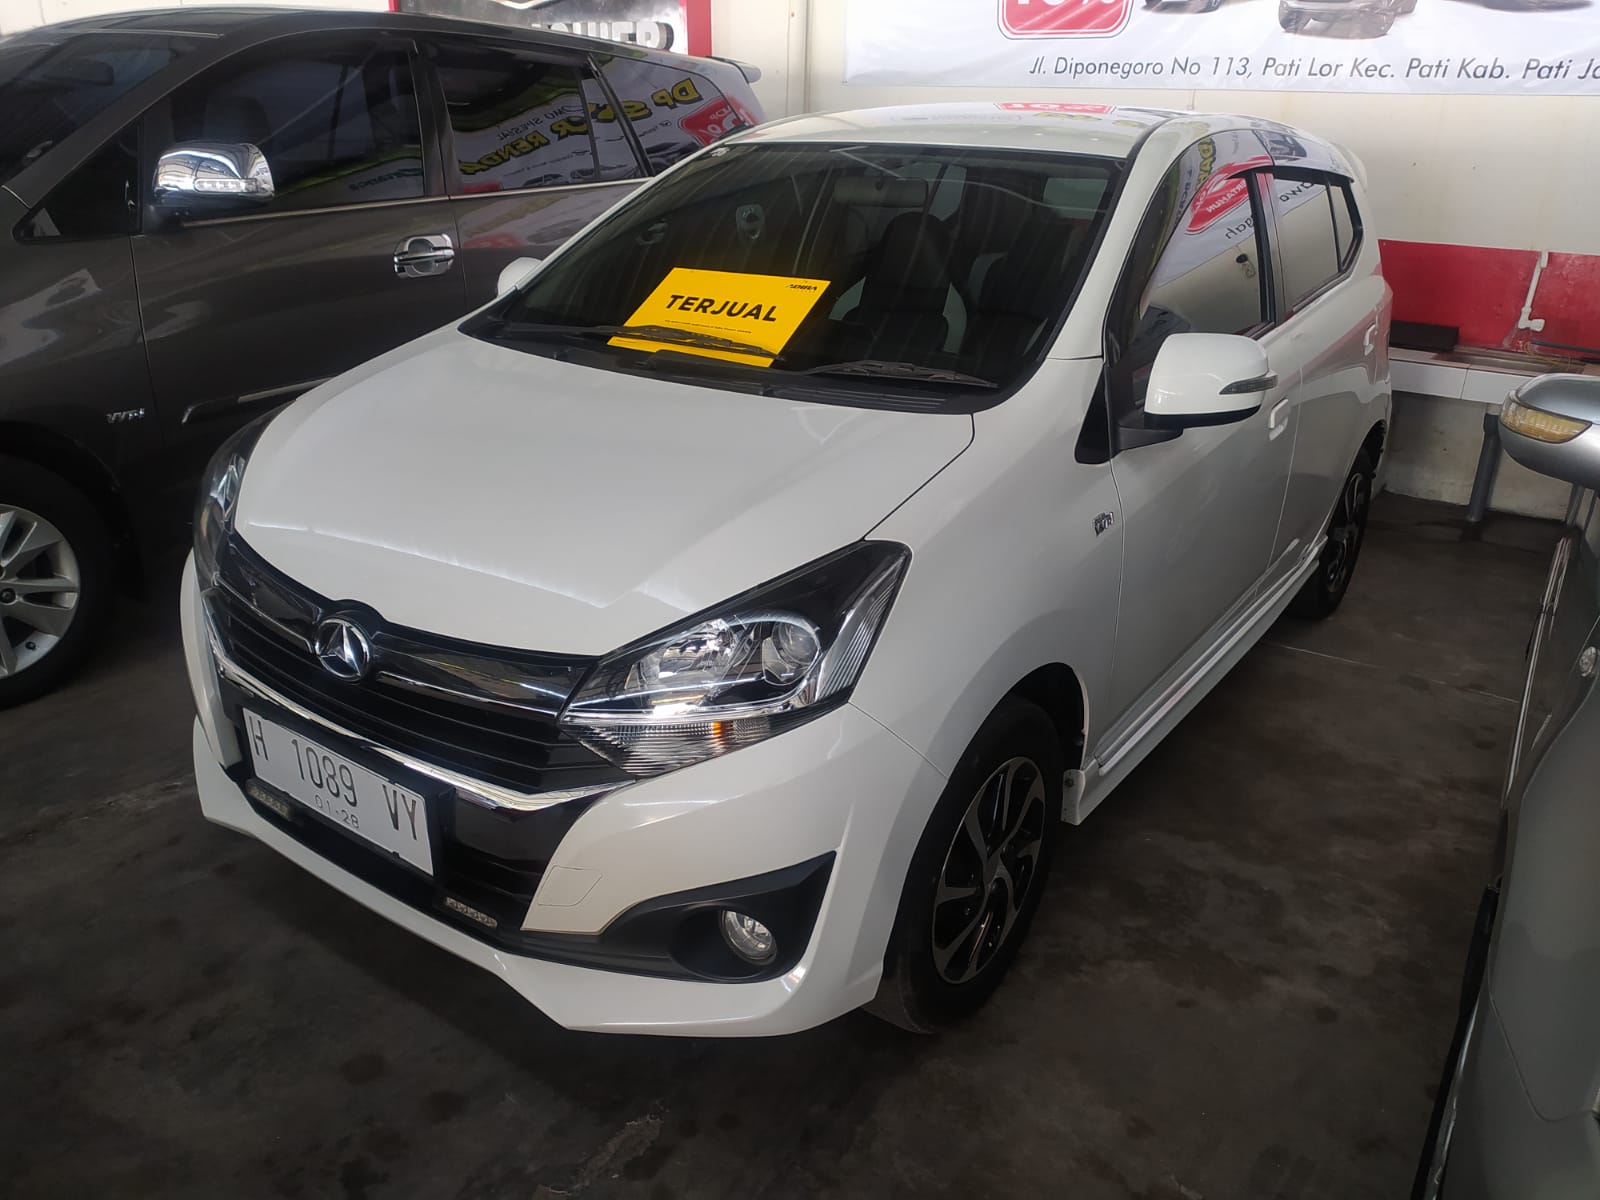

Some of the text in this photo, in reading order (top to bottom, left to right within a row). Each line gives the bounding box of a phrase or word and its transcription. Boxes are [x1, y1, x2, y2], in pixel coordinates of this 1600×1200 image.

[1028, 56, 1046, 75] Jl.
[1053, 57, 1164, 80] Diponegoro
[1170, 57, 1201, 76] No
[1212, 57, 1253, 79] 113,
[1262, 57, 1302, 77] Pati
[1308, 57, 1344, 78] Lor
[1349, 57, 1395, 78] Kec.
[1405, 57, 1450, 79] Pati
[1456, 58, 1510, 80] Kab.
[1521, 58, 1573, 80] Pati
[665, 294, 777, 323] TERJUAL
[249, 715, 417, 842] H 1089 VY
